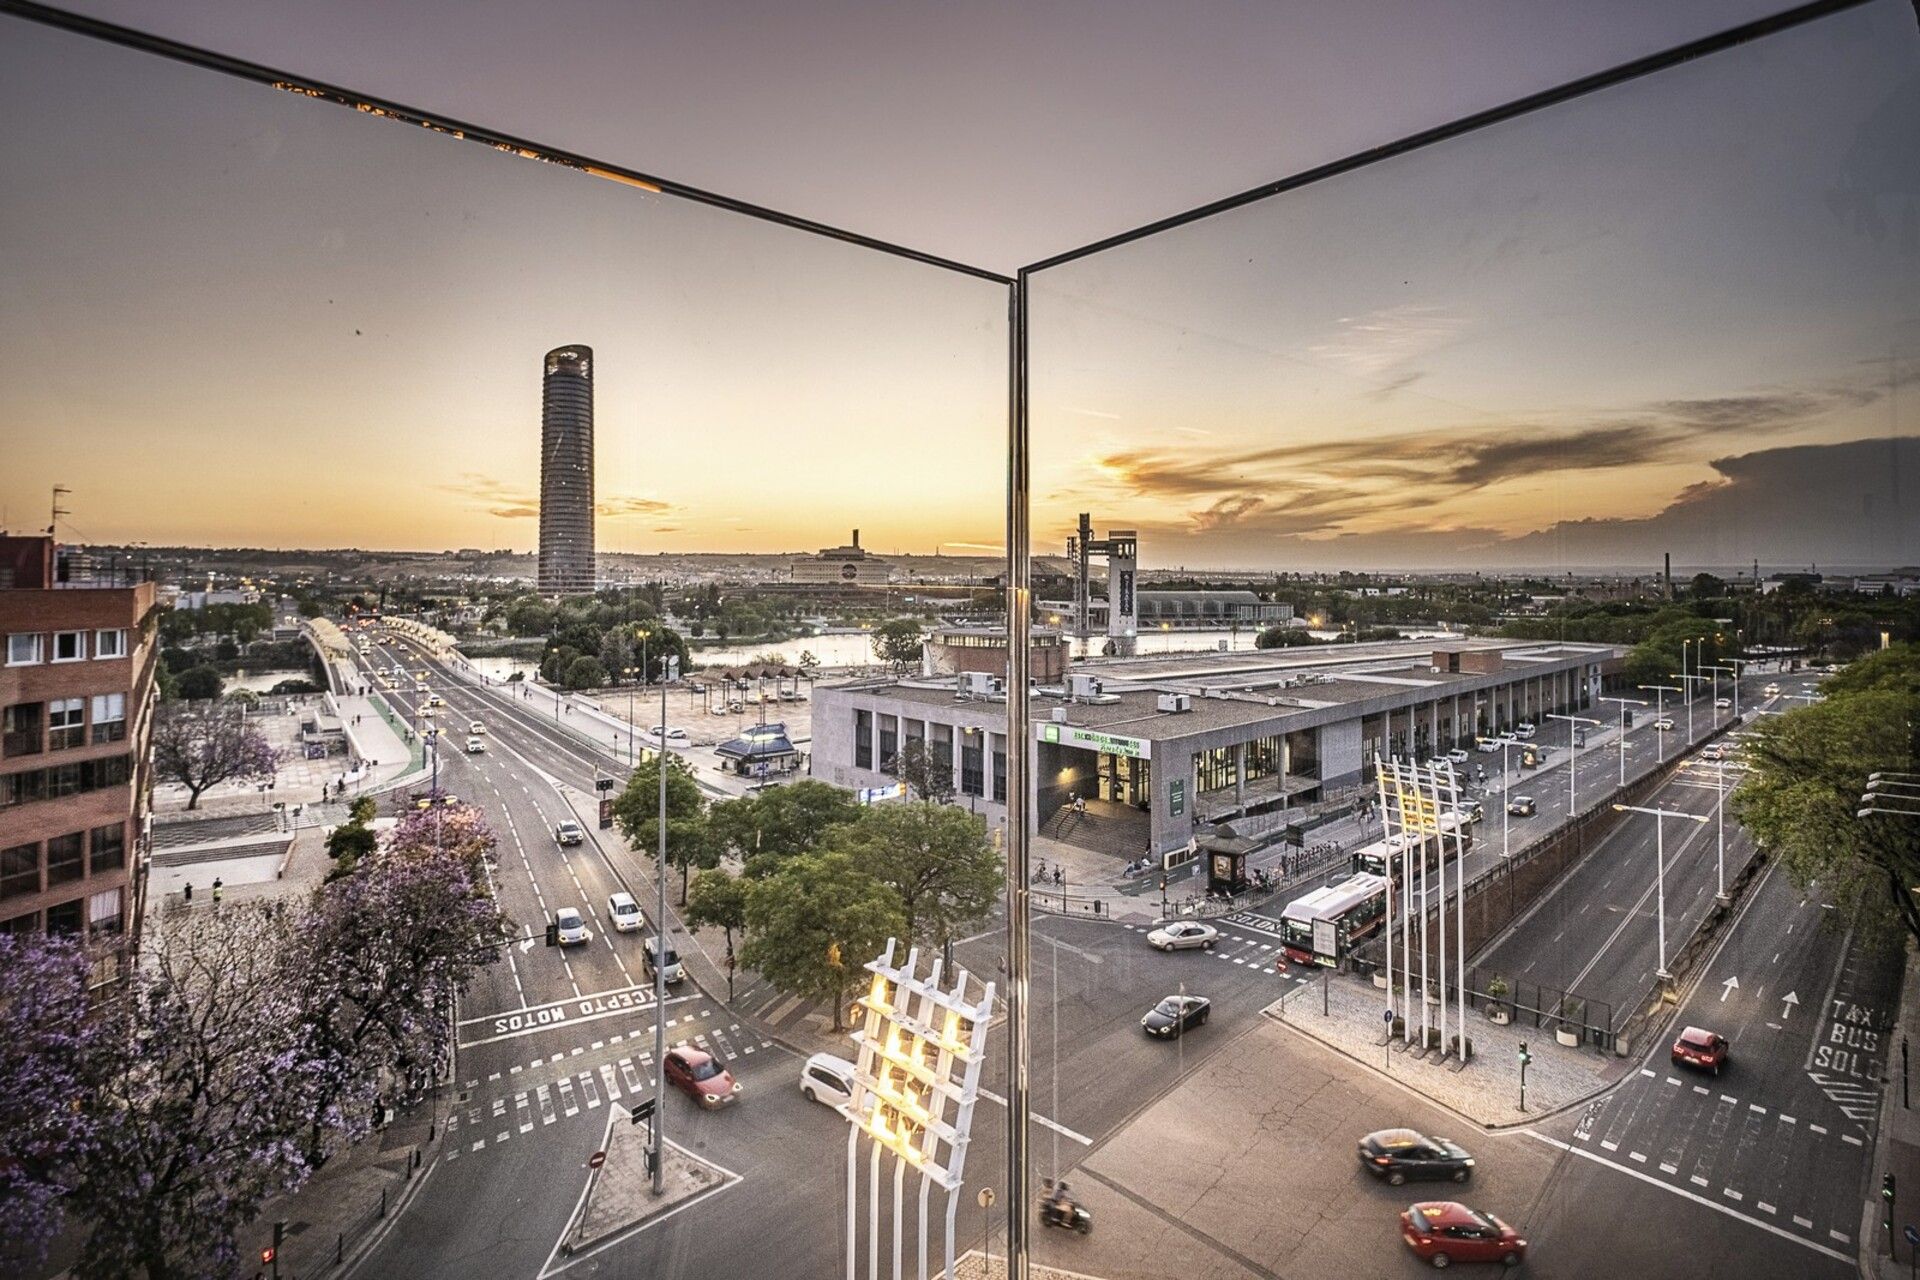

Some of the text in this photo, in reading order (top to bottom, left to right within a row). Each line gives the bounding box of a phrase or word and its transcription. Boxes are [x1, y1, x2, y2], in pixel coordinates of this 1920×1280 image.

[495, 1007, 566, 1033] MOTOS
[1830, 1022, 1879, 1052] BUS
[1815, 1045, 1883, 1081] SOLO
